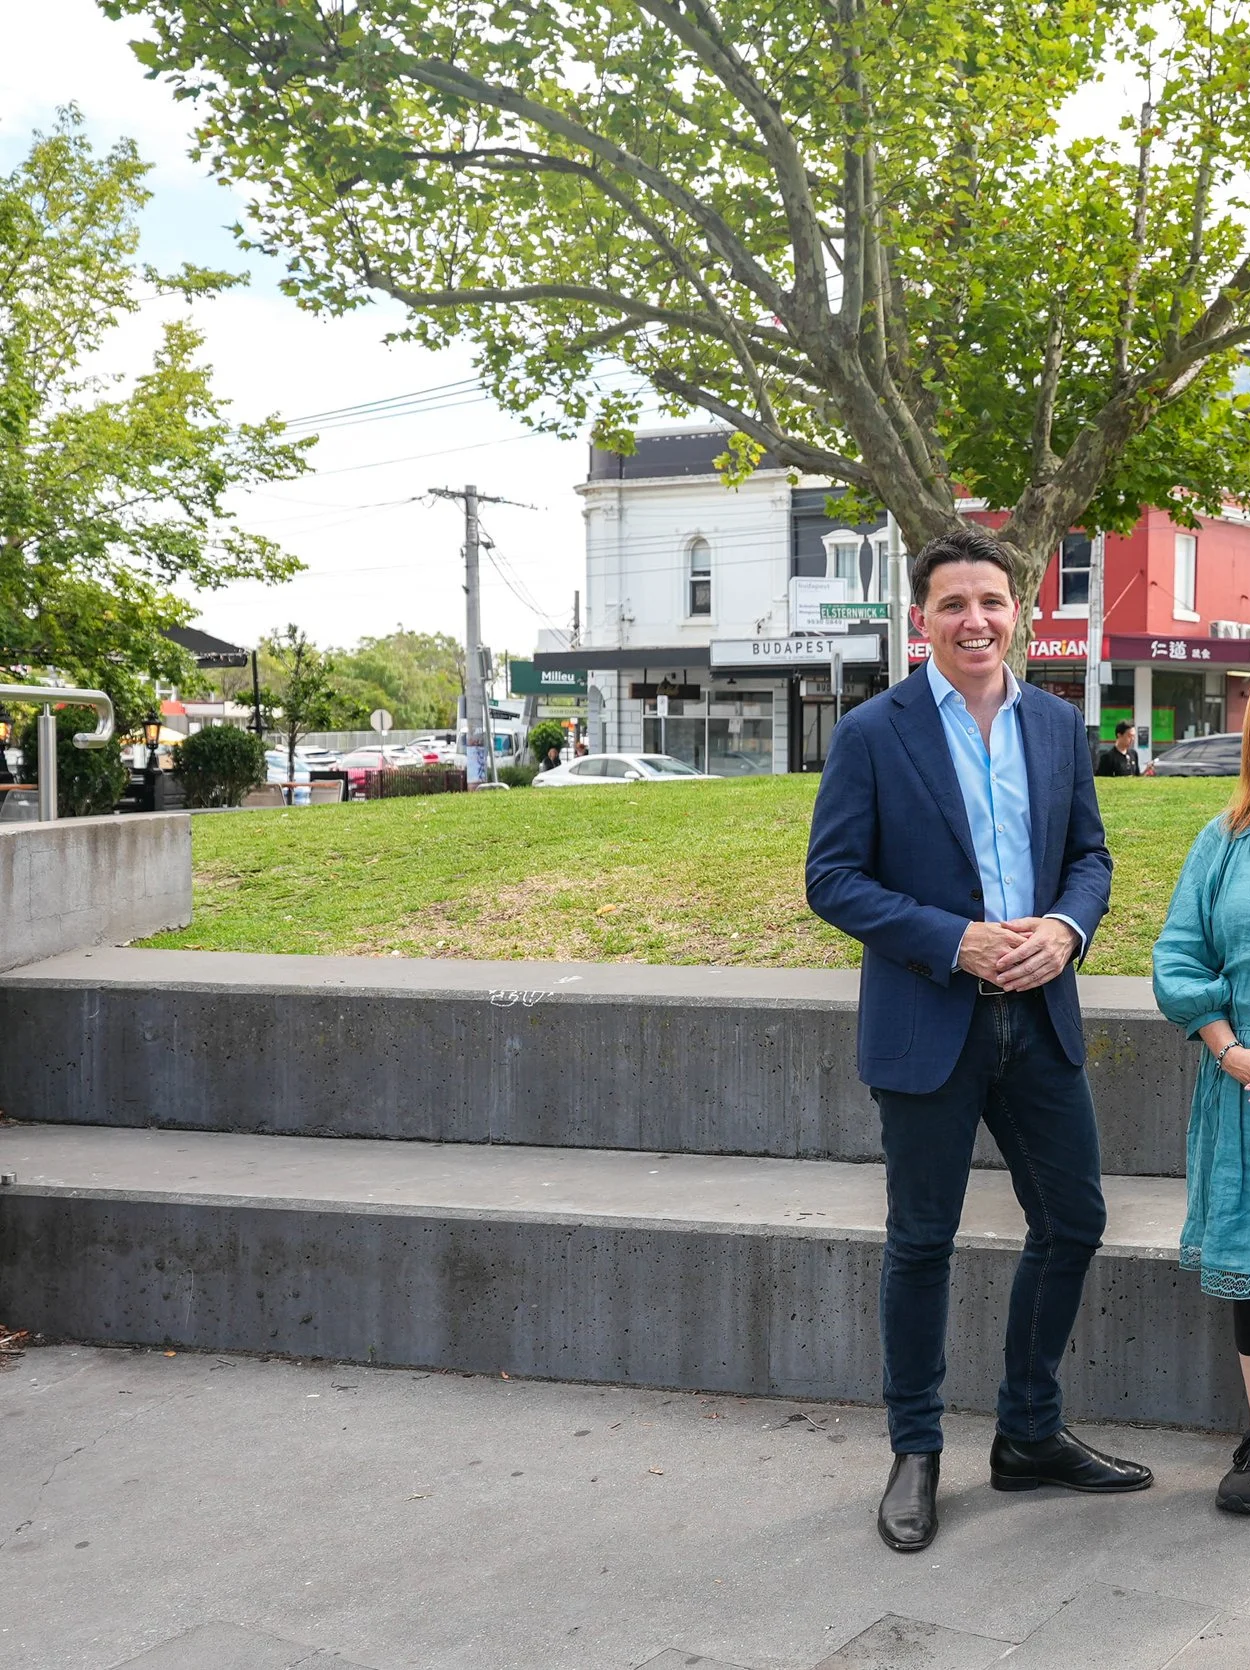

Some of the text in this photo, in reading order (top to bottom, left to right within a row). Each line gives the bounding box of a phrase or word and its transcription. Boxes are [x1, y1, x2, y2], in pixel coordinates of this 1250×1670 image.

[821, 607, 878, 618] ELSTERNWICK
[752, 640, 834, 655] BUDAPEST
[541, 670, 575, 681] Milieu
